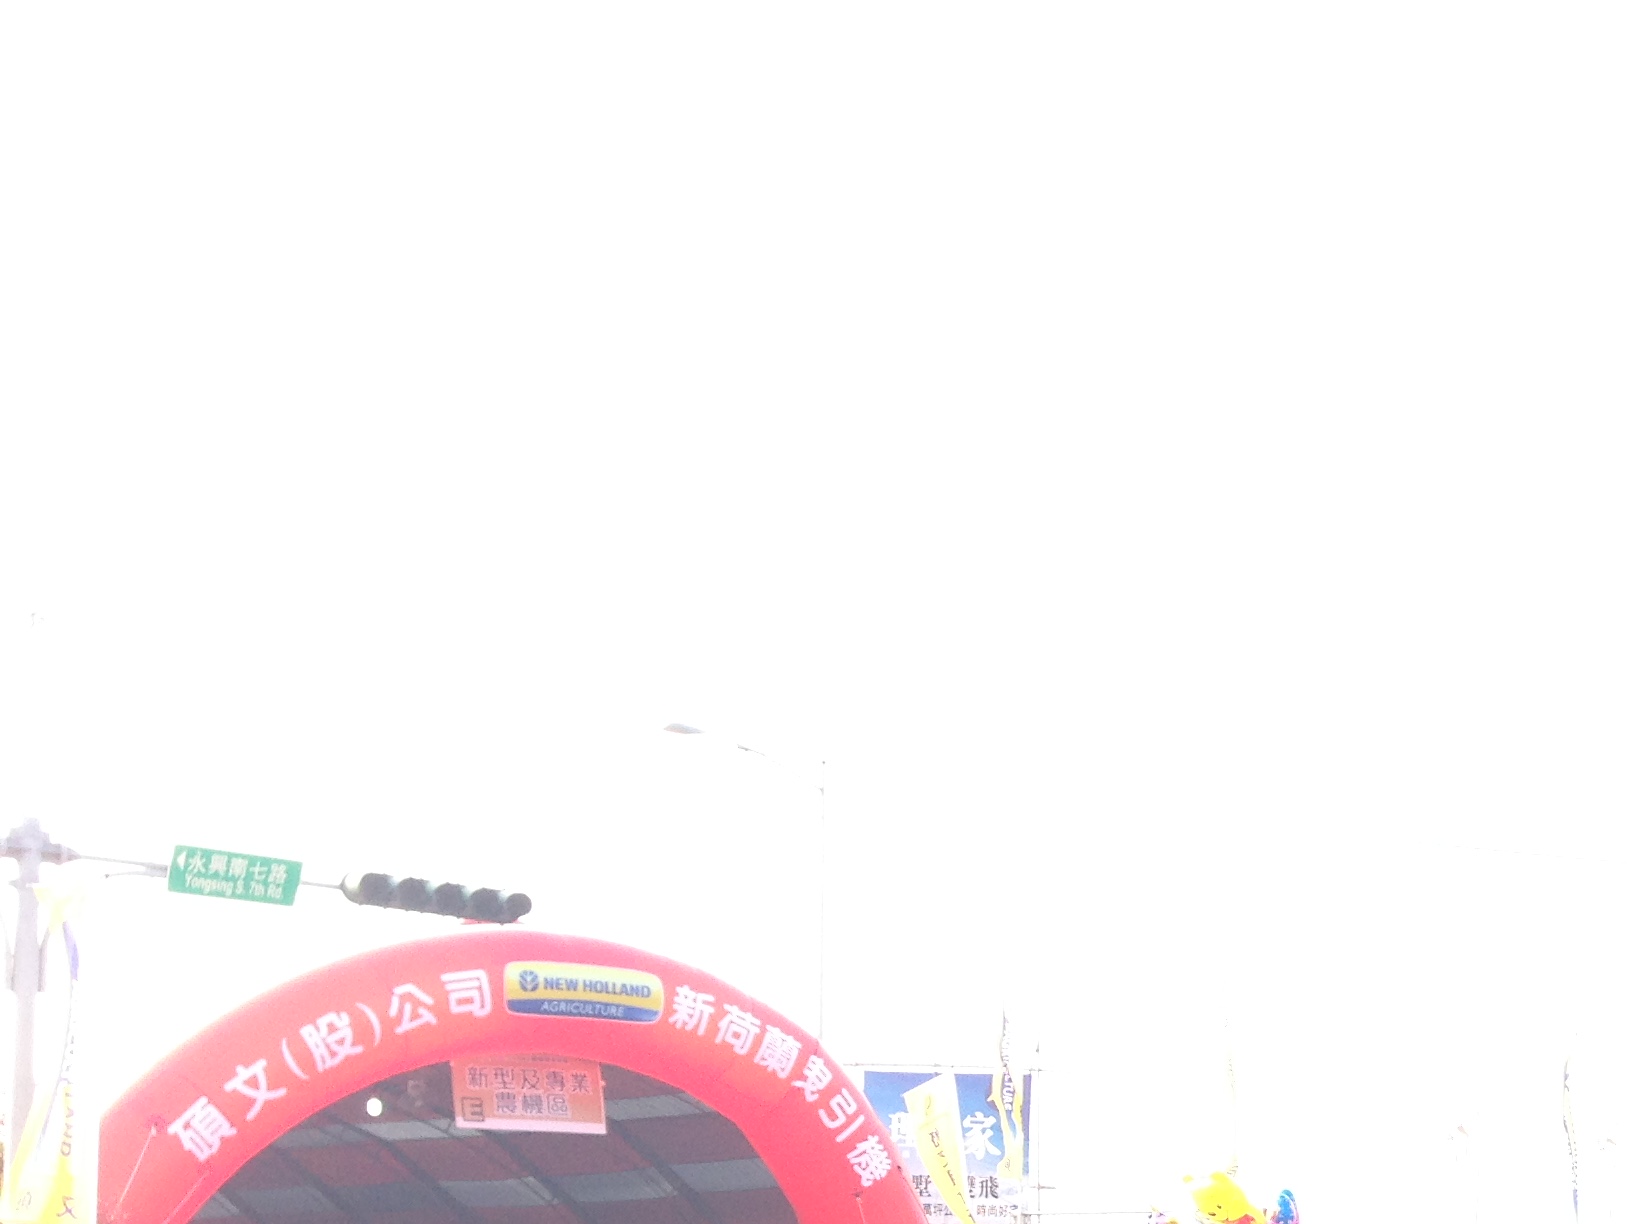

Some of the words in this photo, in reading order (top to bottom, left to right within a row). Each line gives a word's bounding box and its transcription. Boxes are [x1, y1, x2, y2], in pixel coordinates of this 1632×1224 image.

[186, 851, 288, 885] 永興南七路
[543, 976, 579, 993] NEW
[582, 979, 652, 999] HOLLAND
[540, 1001, 625, 1018] AGRICULTURE
[467, 1066, 591, 1093] 新型及專業
[495, 1091, 569, 1117] 農機區
